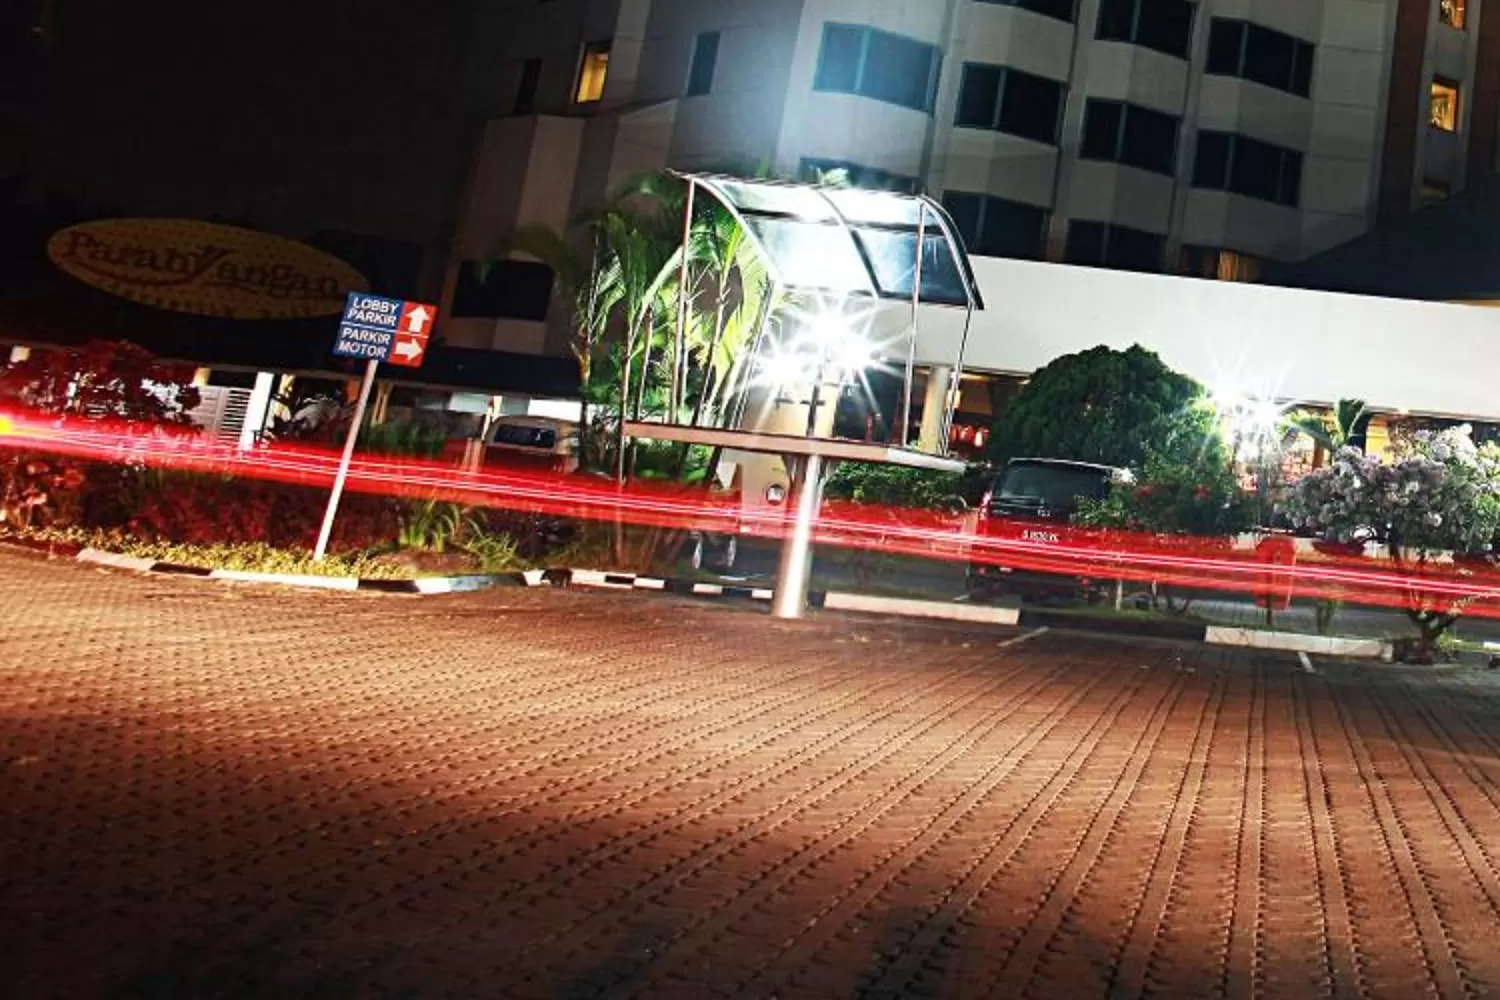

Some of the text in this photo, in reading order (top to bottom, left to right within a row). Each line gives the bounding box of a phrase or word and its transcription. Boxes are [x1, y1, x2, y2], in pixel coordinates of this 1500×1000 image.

[353, 297, 399, 313] LOBBY
[347, 308, 396, 326] PARKIR
[342, 328, 391, 345] PARKIR
[339, 341, 387, 358] MOTOR
